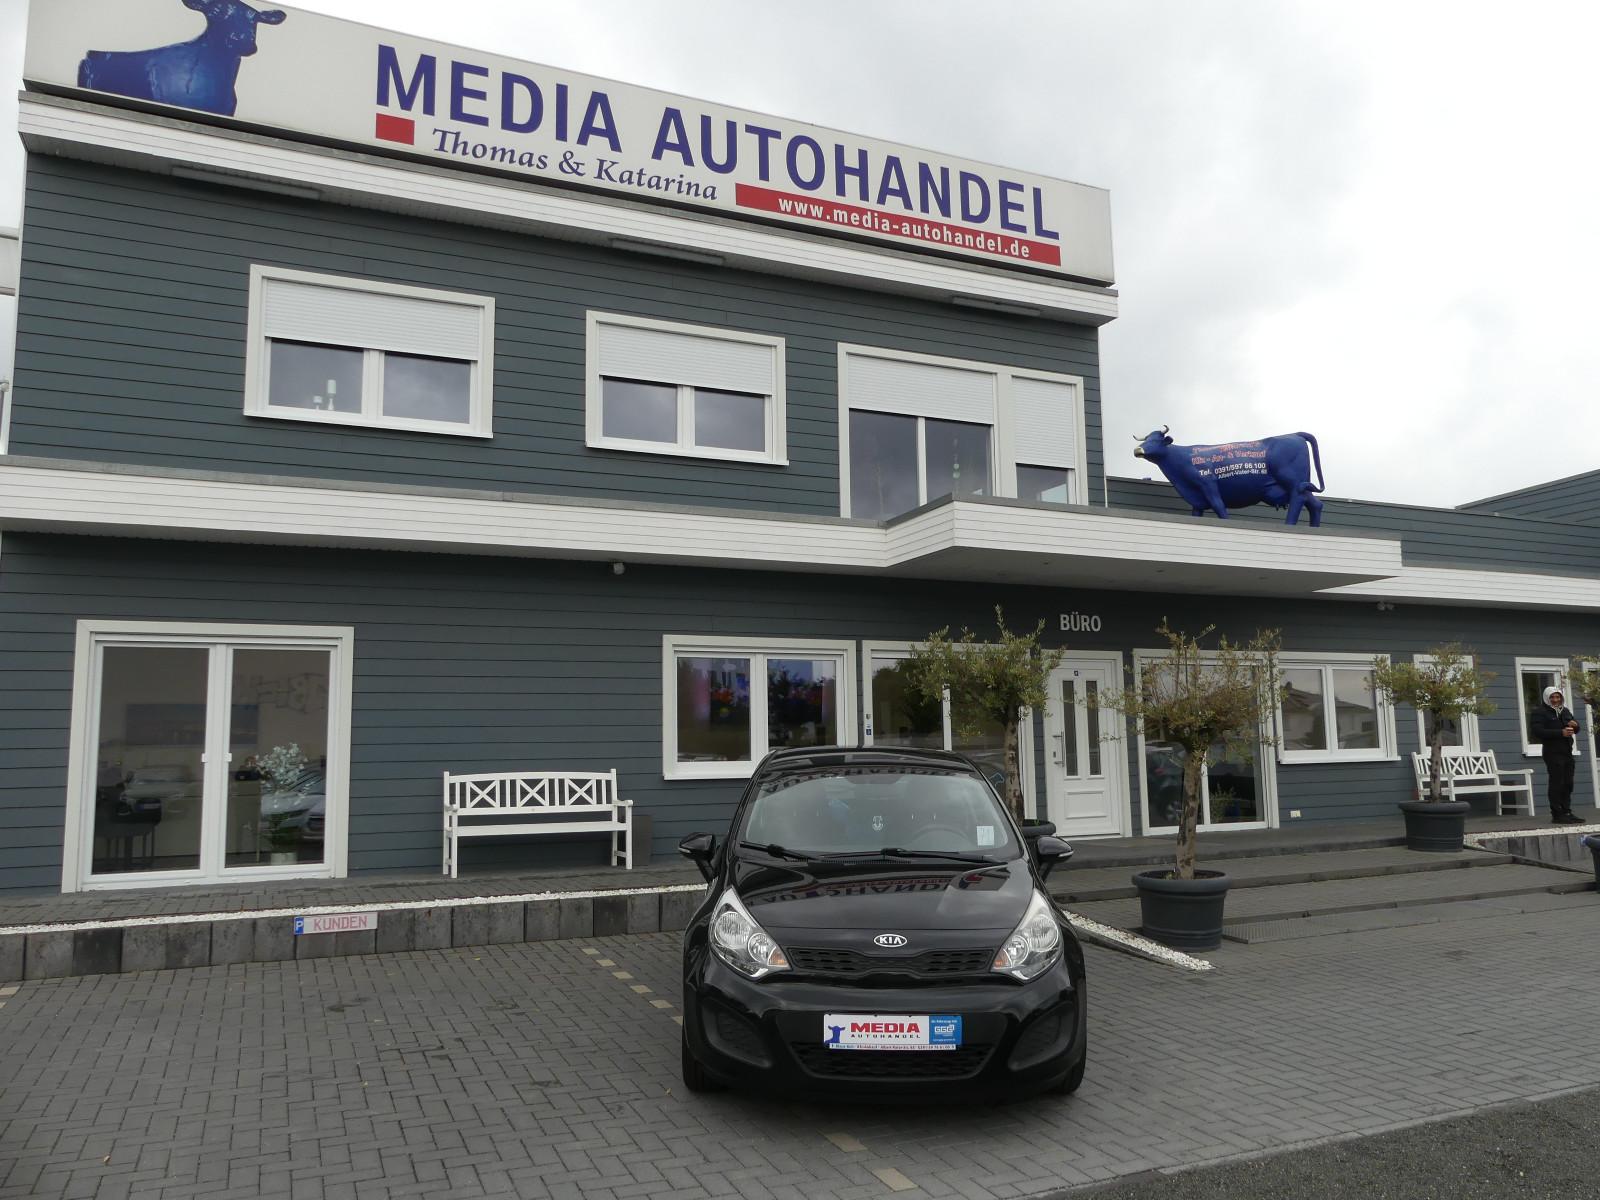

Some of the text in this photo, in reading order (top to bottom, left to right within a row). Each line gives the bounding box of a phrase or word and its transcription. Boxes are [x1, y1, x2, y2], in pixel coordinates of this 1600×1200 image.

[376, 44, 1060, 241] MEDIA AUTOHANDEL
[432, 127, 718, 201] Thomas & Katarina
[778, 198, 1030, 259] www.media-autohandel.de
[1199, 468, 1212, 476] Tel.
[1060, 611, 1102, 632] BÜRO
[296, 915, 368, 931] P KUNDEN
[879, 936, 902, 945] KIA
[850, 1022, 920, 1033] MEDIA
